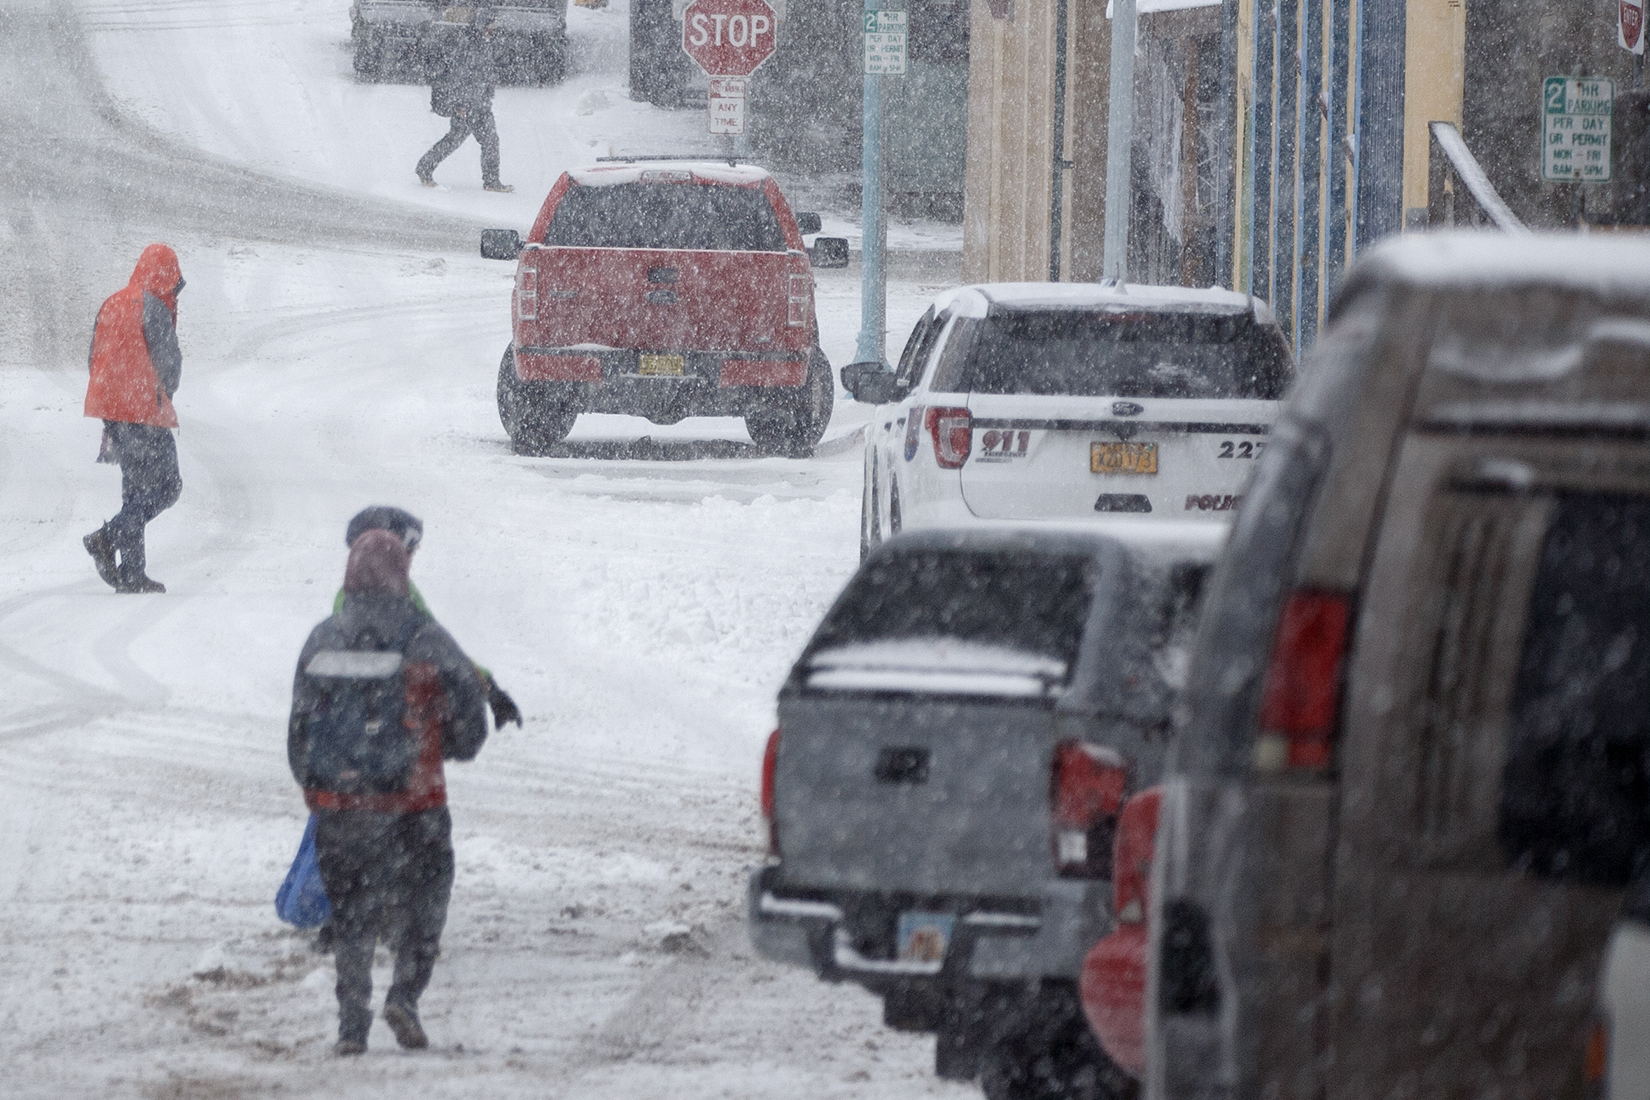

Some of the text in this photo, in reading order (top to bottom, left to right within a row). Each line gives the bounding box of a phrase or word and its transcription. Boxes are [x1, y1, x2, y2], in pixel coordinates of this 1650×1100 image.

[866, 13, 876, 30] 2
[1623, 6, 1638, 27] ENTER
[690, 13, 770, 48] STOP
[1548, 83, 1564, 108] 2
[718, 103, 738, 112] ANY
[1567, 99, 1611, 114] PARKING
[714, 118, 738, 127] TIME
[1553, 118, 1604, 130] PER DAY
[1550, 133, 1608, 146] OR PERMIT
[1553, 149, 1572, 159] MON
[1586, 150, 1601, 161] FRI
[1584, 165, 1603, 176] 5PM
[982, 430, 1031, 452] 911
